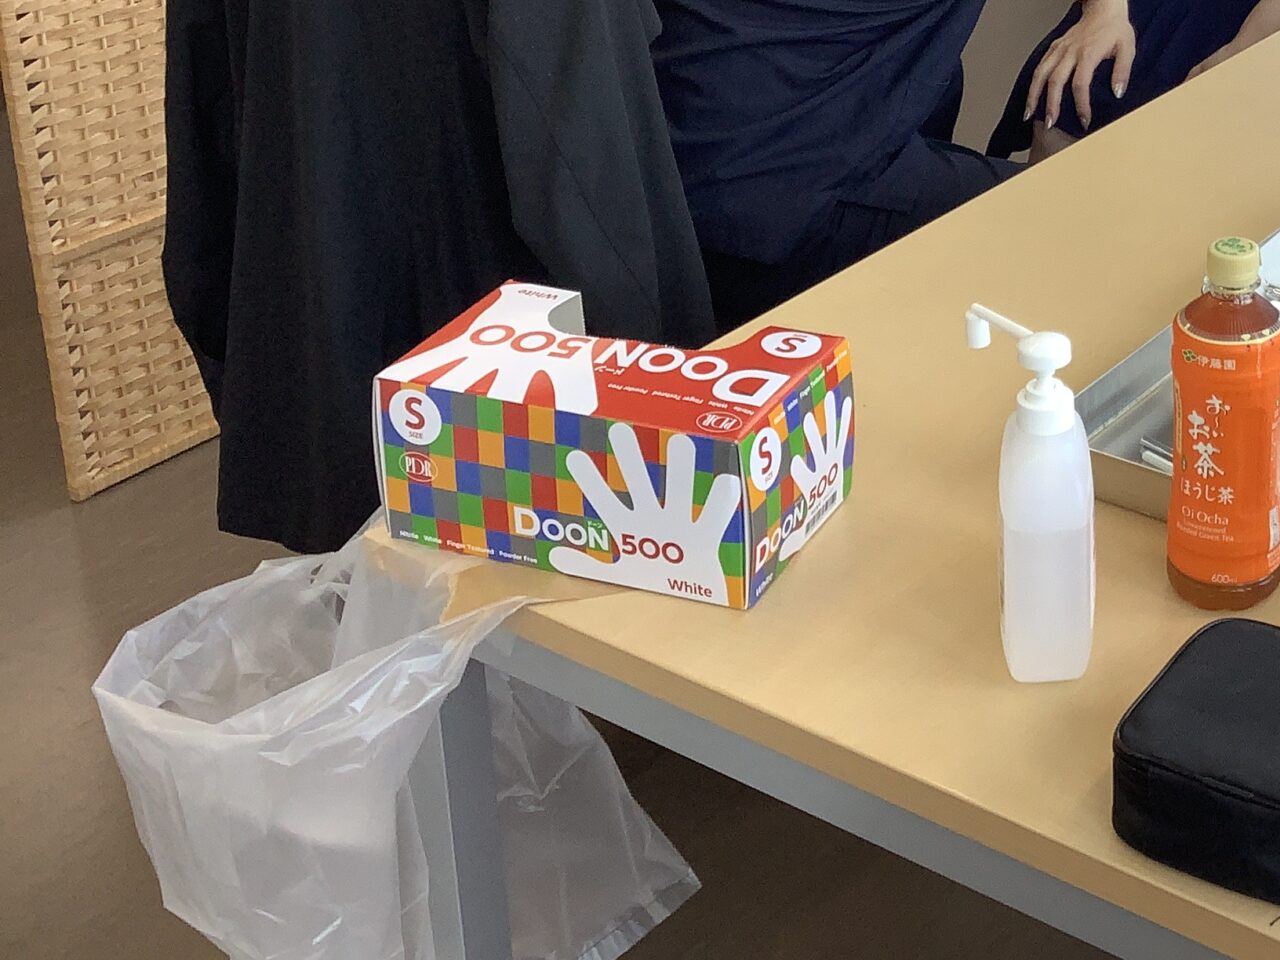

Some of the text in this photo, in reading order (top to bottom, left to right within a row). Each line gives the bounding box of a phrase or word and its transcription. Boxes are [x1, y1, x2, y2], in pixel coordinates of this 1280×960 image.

[518, 289, 558, 300] White
[775, 337, 807, 353] S
[470, 324, 791, 407] DOON 500
[1197, 355, 1236, 370] 伊藤園
[405, 396, 425, 430] S
[408, 430, 423, 439] SIZE
[1187, 409, 1225, 479] お茶
[758, 436, 772, 475] S
[1181, 477, 1235, 505] ほうじ茶
[754, 462, 839, 574] DOON 500
[1181, 505, 1229, 525] Oi Ocha
[423, 534, 442, 544] White
[447, 539, 466, 550] Finger
[499, 550, 523, 561] Powder
[523, 554, 538, 564] Free
[513, 505, 685, 565] DOON 500
[667, 577, 713, 598] White
